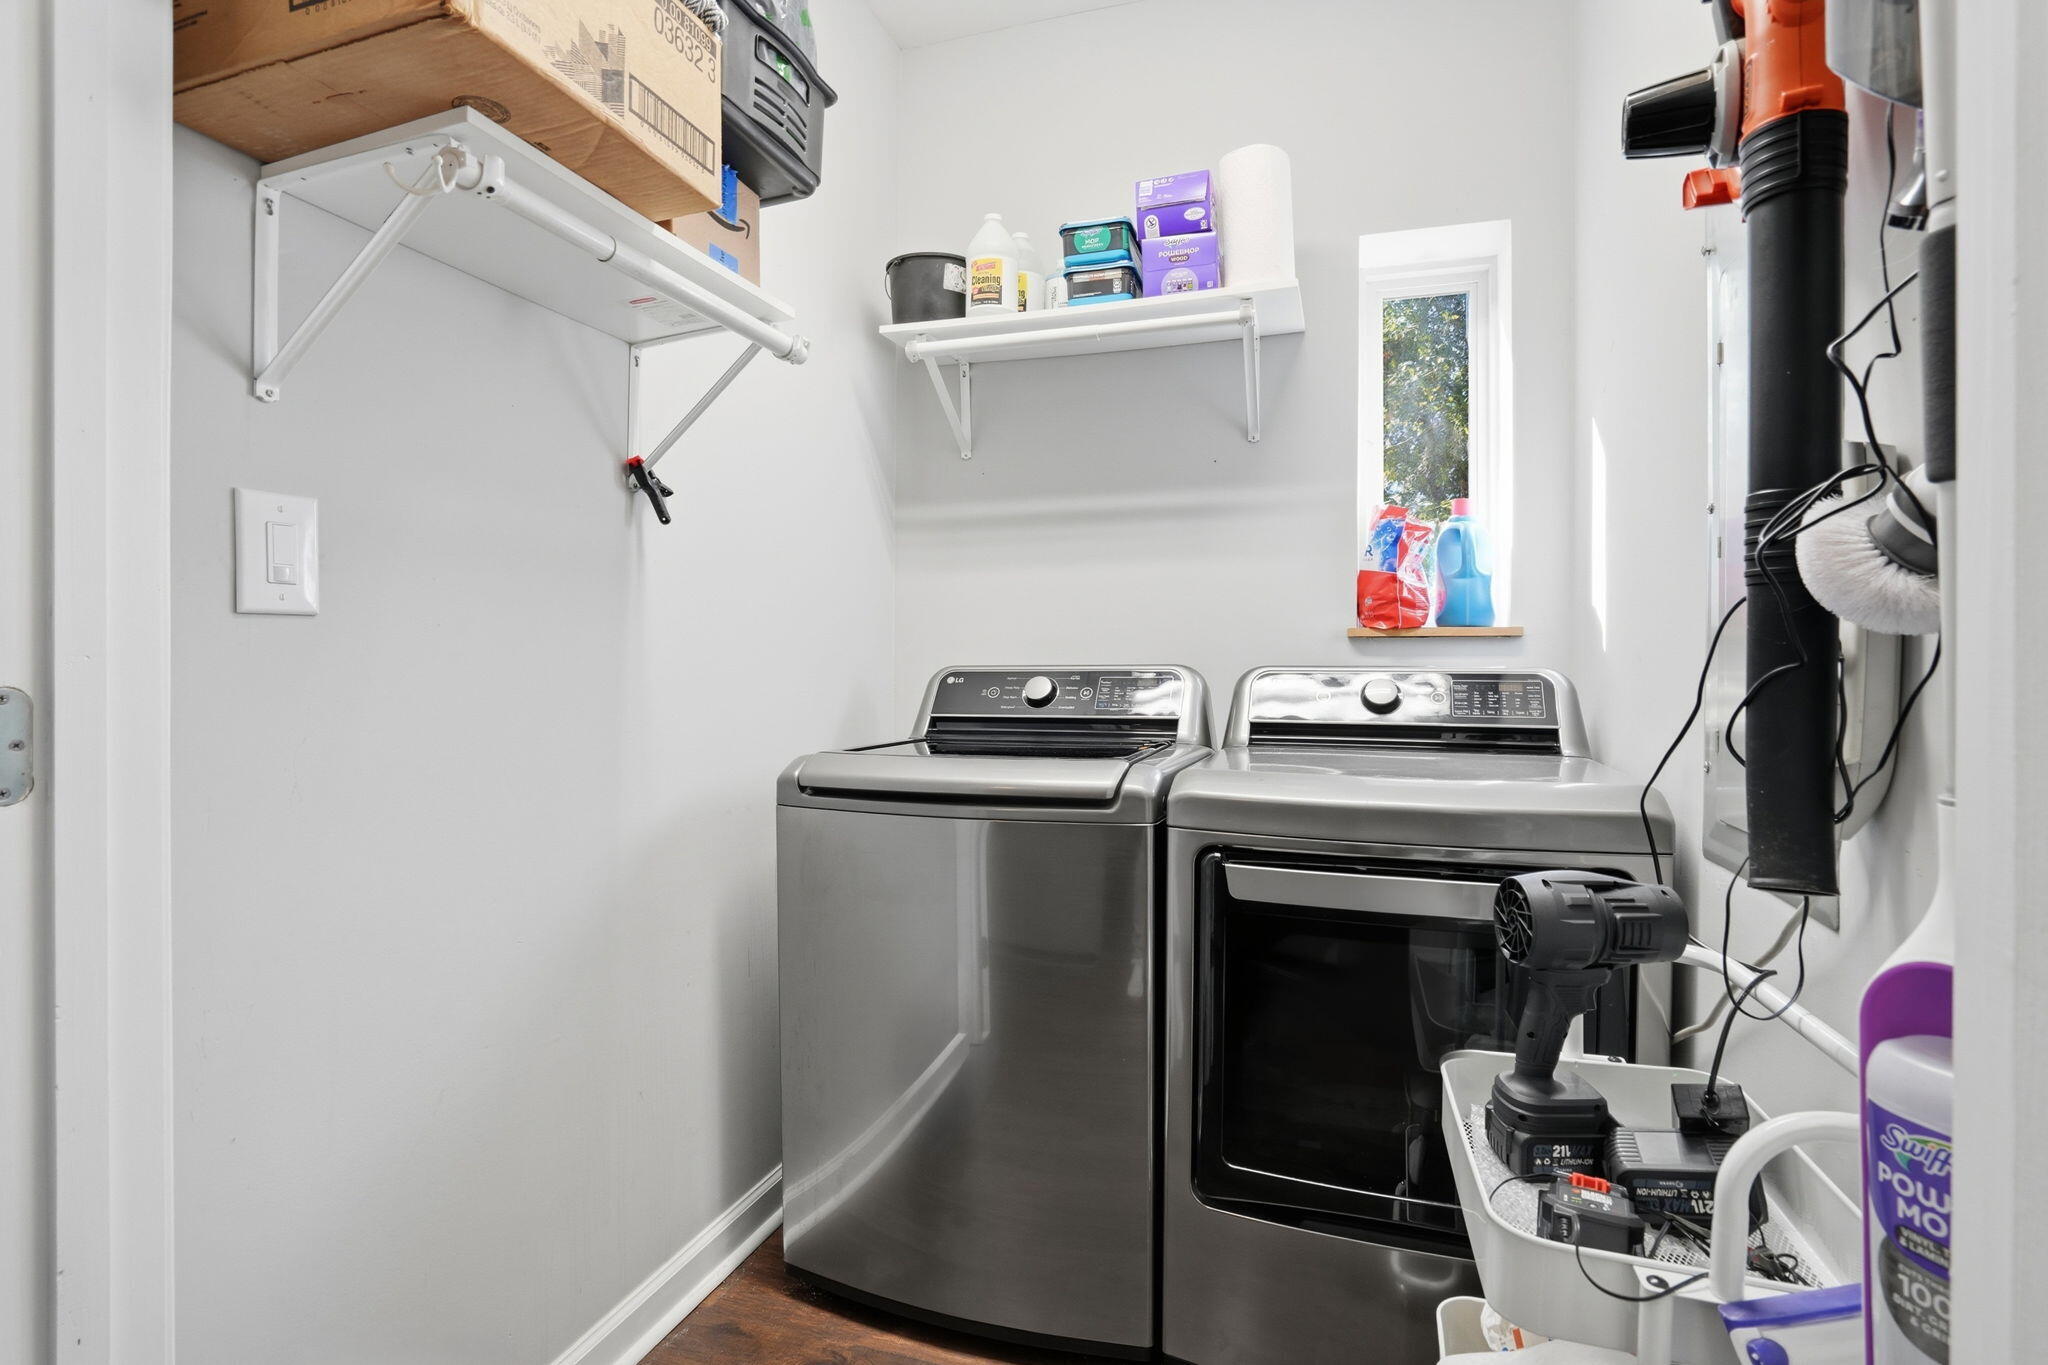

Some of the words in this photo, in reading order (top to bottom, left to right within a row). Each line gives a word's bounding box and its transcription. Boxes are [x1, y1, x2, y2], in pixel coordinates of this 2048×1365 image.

[654, 6, 704, 73] 03632
[708, 57, 716, 83] 3
[972, 273, 1001, 286] Cleaning
[1636, 1187, 1678, 1198] LITHIUM-ION
[1897, 1273, 1952, 1319] 100
